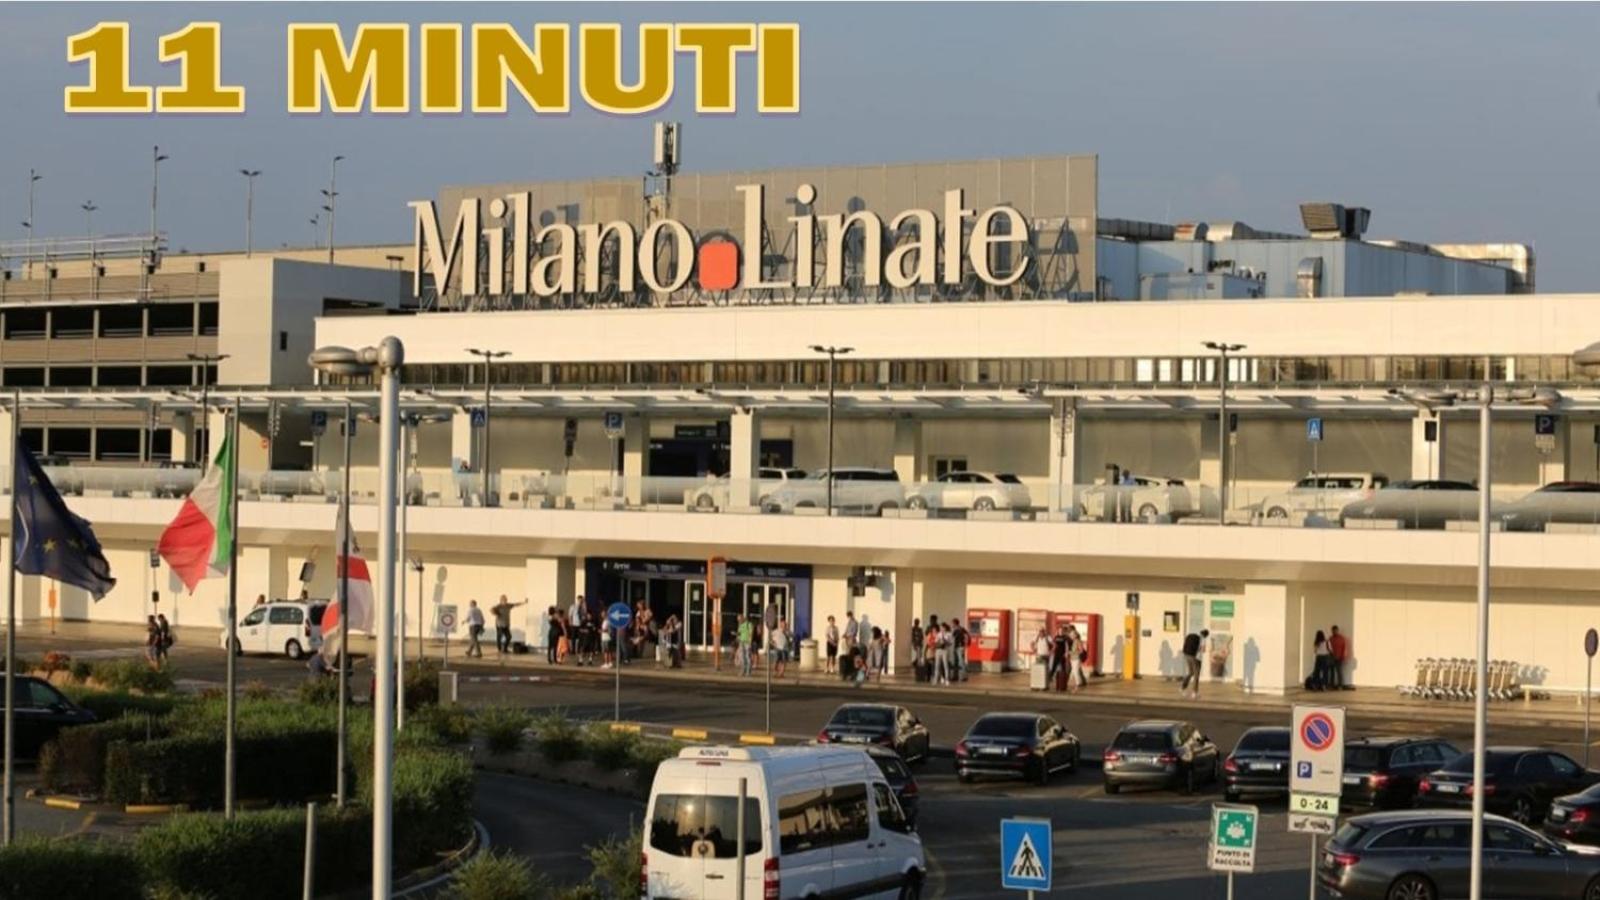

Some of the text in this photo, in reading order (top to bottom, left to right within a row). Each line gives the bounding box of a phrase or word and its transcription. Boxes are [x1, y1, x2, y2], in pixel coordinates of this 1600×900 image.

[407, 183, 1030, 297] Milano Linate
[1539, 416, 1551, 433] P
[1299, 763, 1310, 775] P
[1300, 797, 1308, 809] 0
[1315, 799, 1329, 810] 24
[1215, 858, 1251, 867] RACCOLTA
